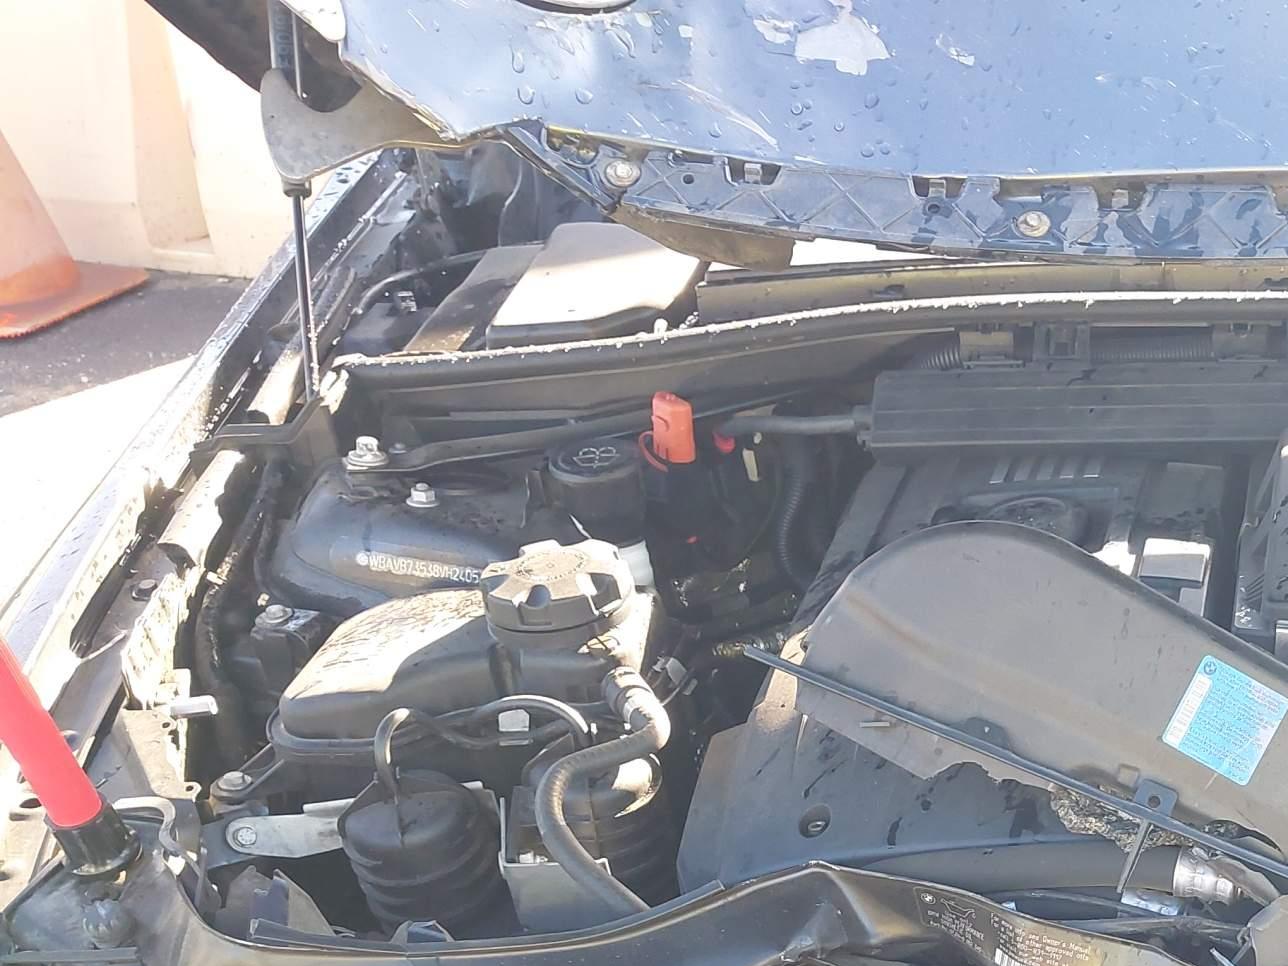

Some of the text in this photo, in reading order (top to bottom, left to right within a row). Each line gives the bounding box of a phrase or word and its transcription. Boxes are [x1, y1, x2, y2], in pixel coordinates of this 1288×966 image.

[1042, 935, 1067, 948] Owner's
[1069, 942, 1091, 955] Manual
[1045, 945, 1074, 958] approved
